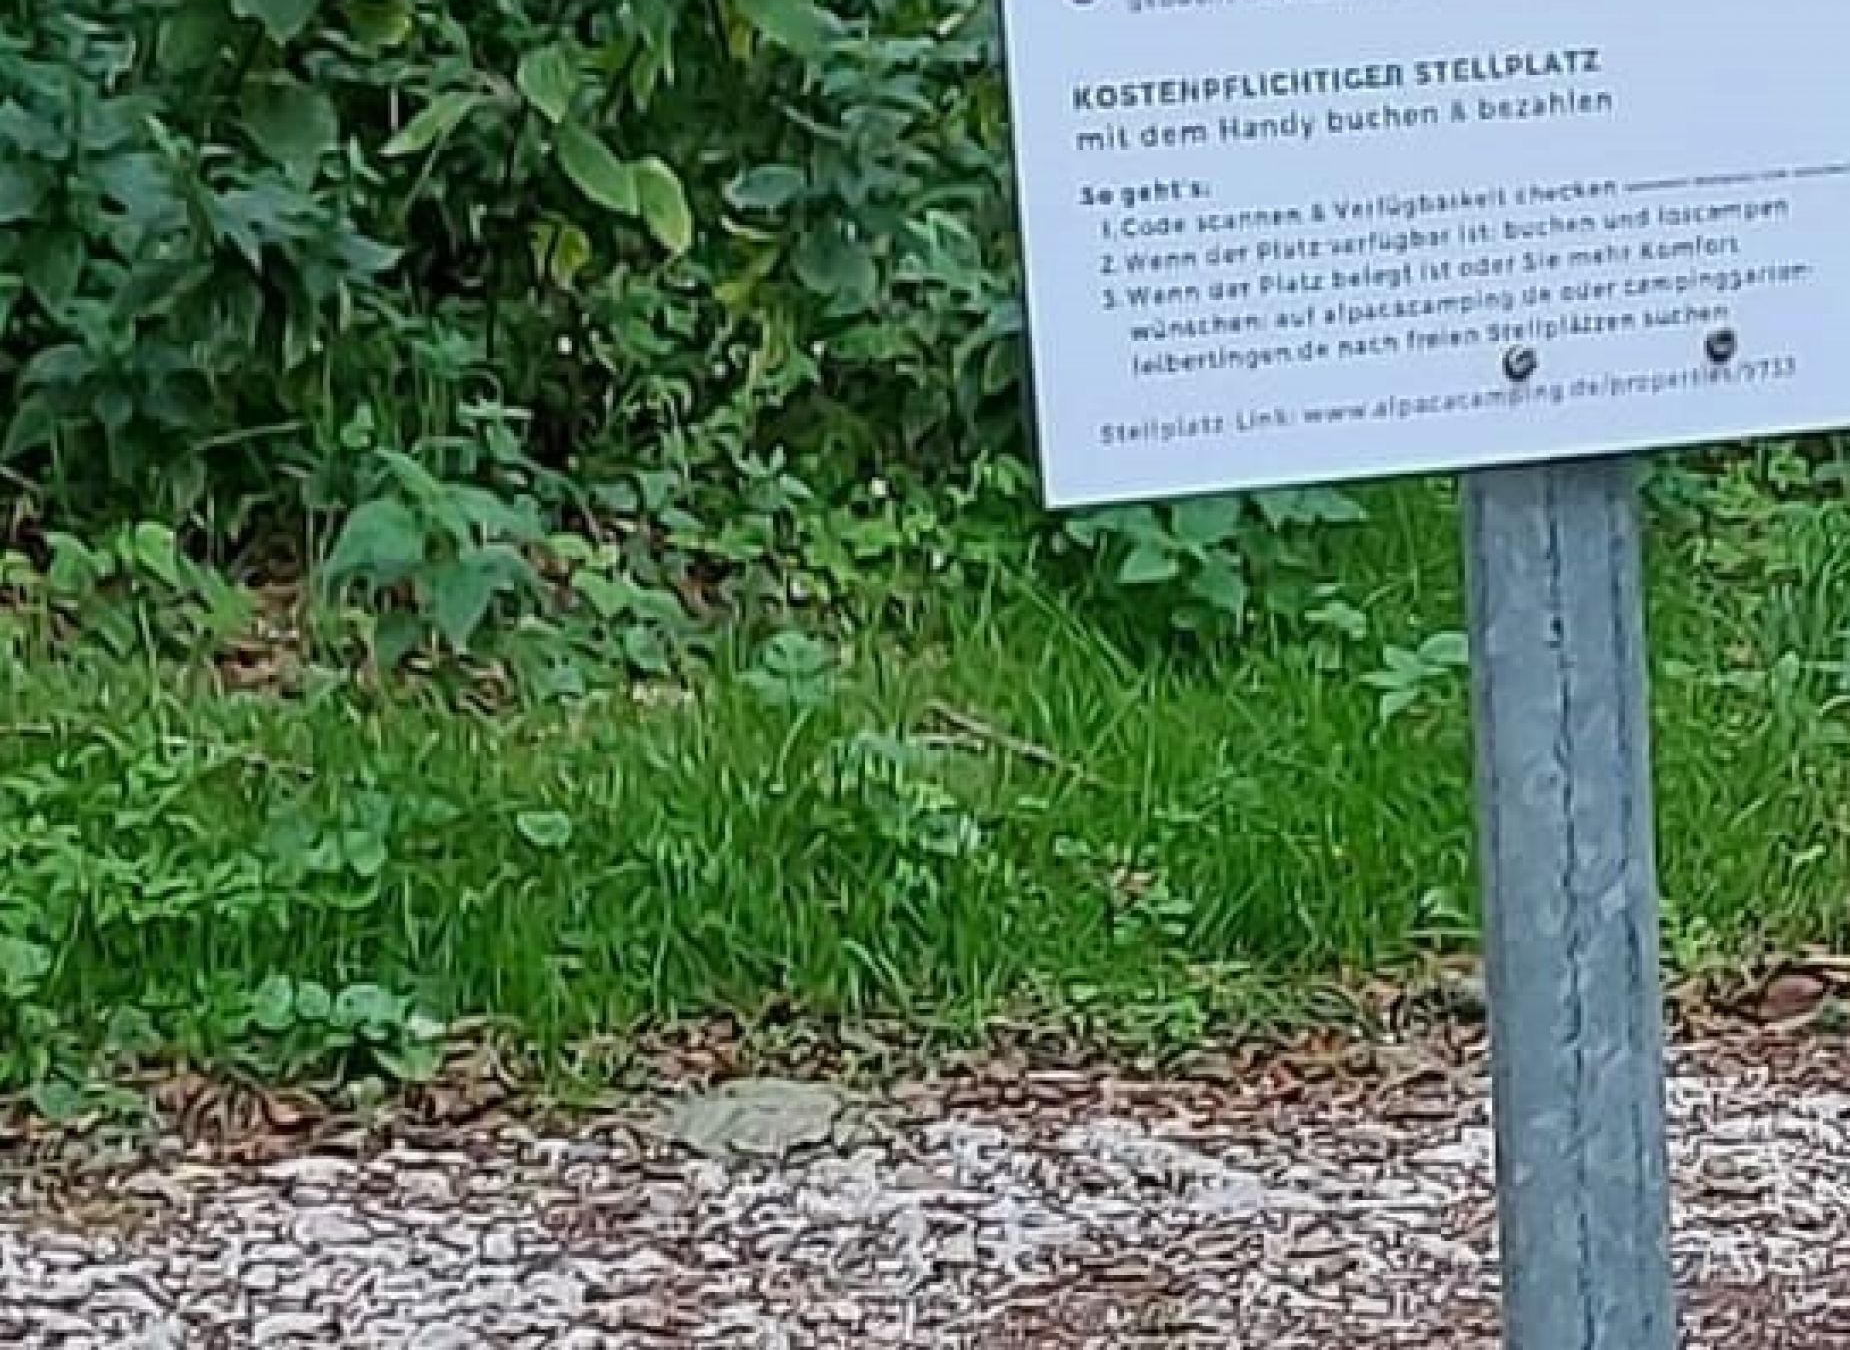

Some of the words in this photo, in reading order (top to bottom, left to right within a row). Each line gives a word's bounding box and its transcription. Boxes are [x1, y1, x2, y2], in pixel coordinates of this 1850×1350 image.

[1072, 62, 1403, 109] KOSTENPFLICHTIGER
[1415, 47, 1600, 87] STELLPLATZ
[1076, 122, 1127, 150] mit
[1140, 121, 1206, 148] dem
[1219, 109, 1312, 142] Handy
[1327, 100, 1439, 134] buchen
[1478, 87, 1612, 120] bezahlen
[1080, 186, 1114, 206] So
